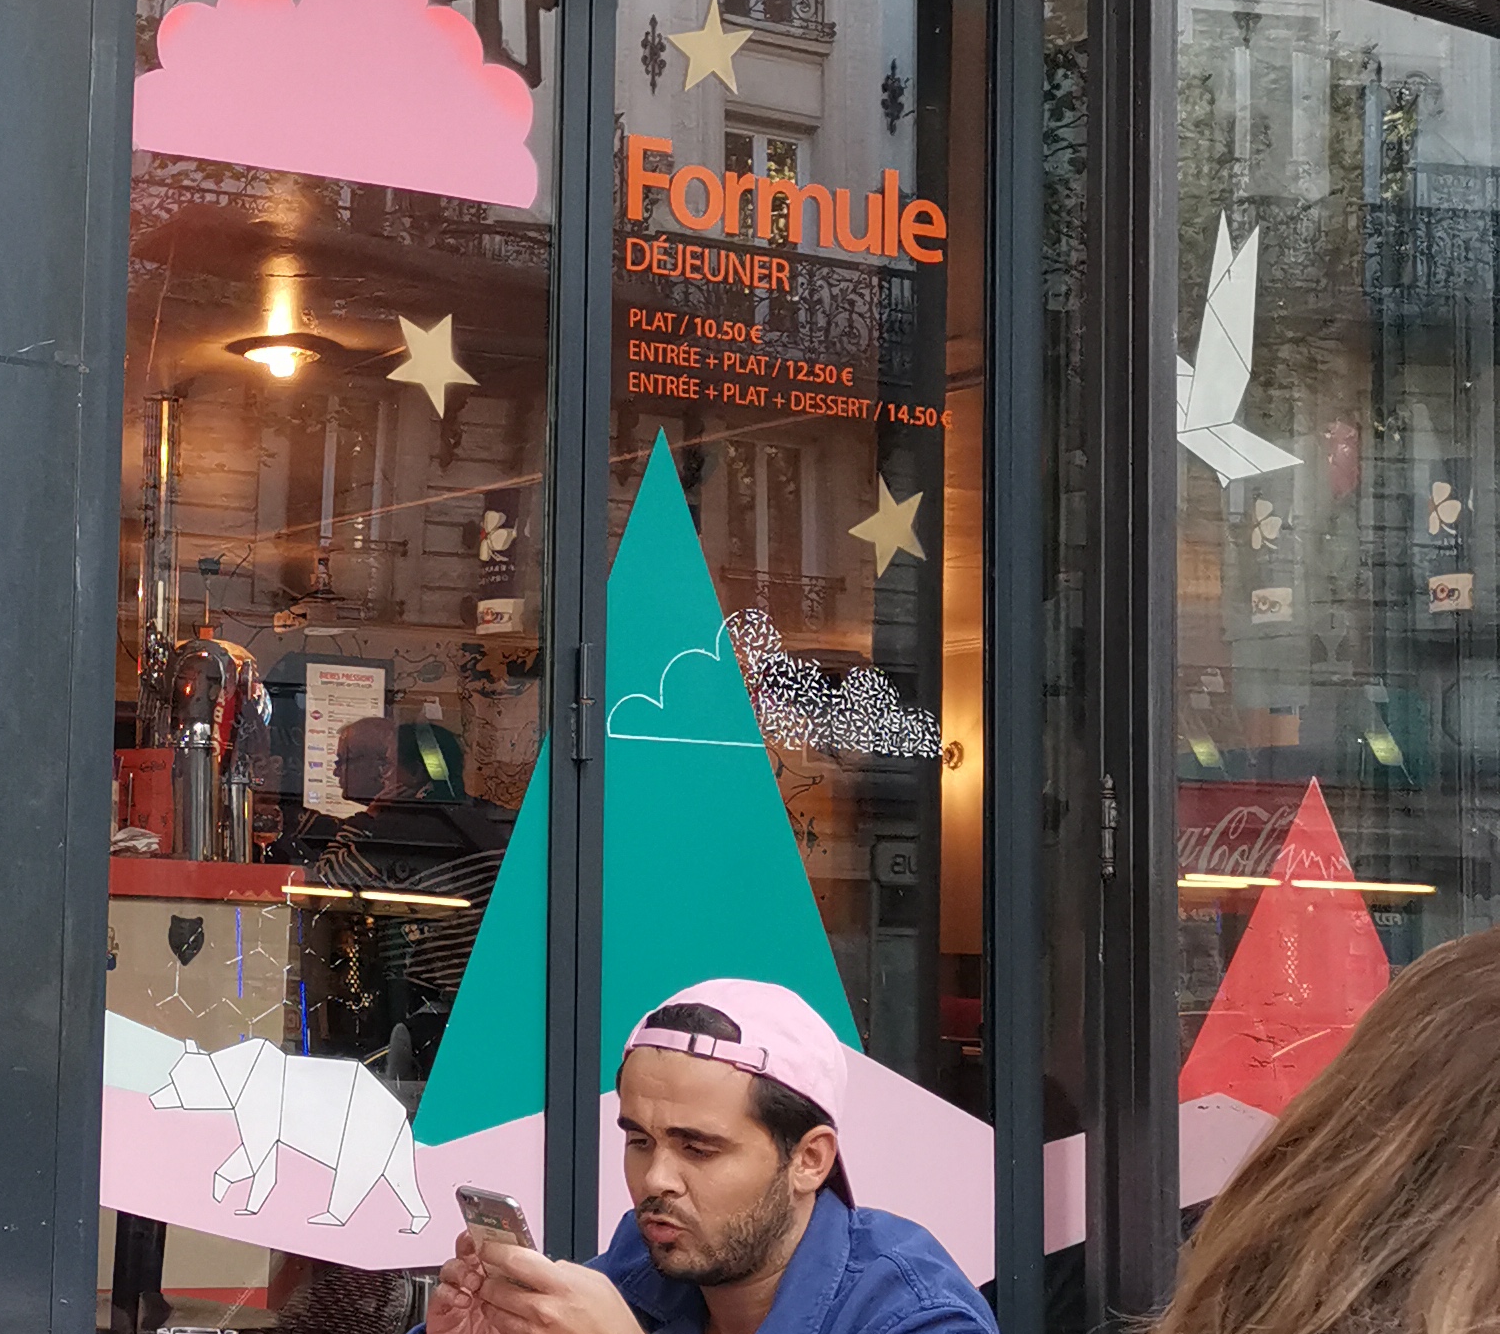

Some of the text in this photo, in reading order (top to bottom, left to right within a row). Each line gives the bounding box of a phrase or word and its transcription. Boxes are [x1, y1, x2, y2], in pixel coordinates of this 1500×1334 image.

[627, 133, 947, 264] Formule
[625, 235, 790, 292] DÉJEUNER
[629, 308, 677, 335] PLAT
[694, 317, 745, 342] 10.50
[629, 340, 701, 368] ENTRÉE
[723, 351, 769, 377] PLAT
[785, 360, 837, 385] 12.50
[629, 371, 700, 400] ENTRÉE
[723, 382, 769, 408] PLAT
[790, 391, 871, 419] DESSERT
[888, 403, 938, 428] 14.50
